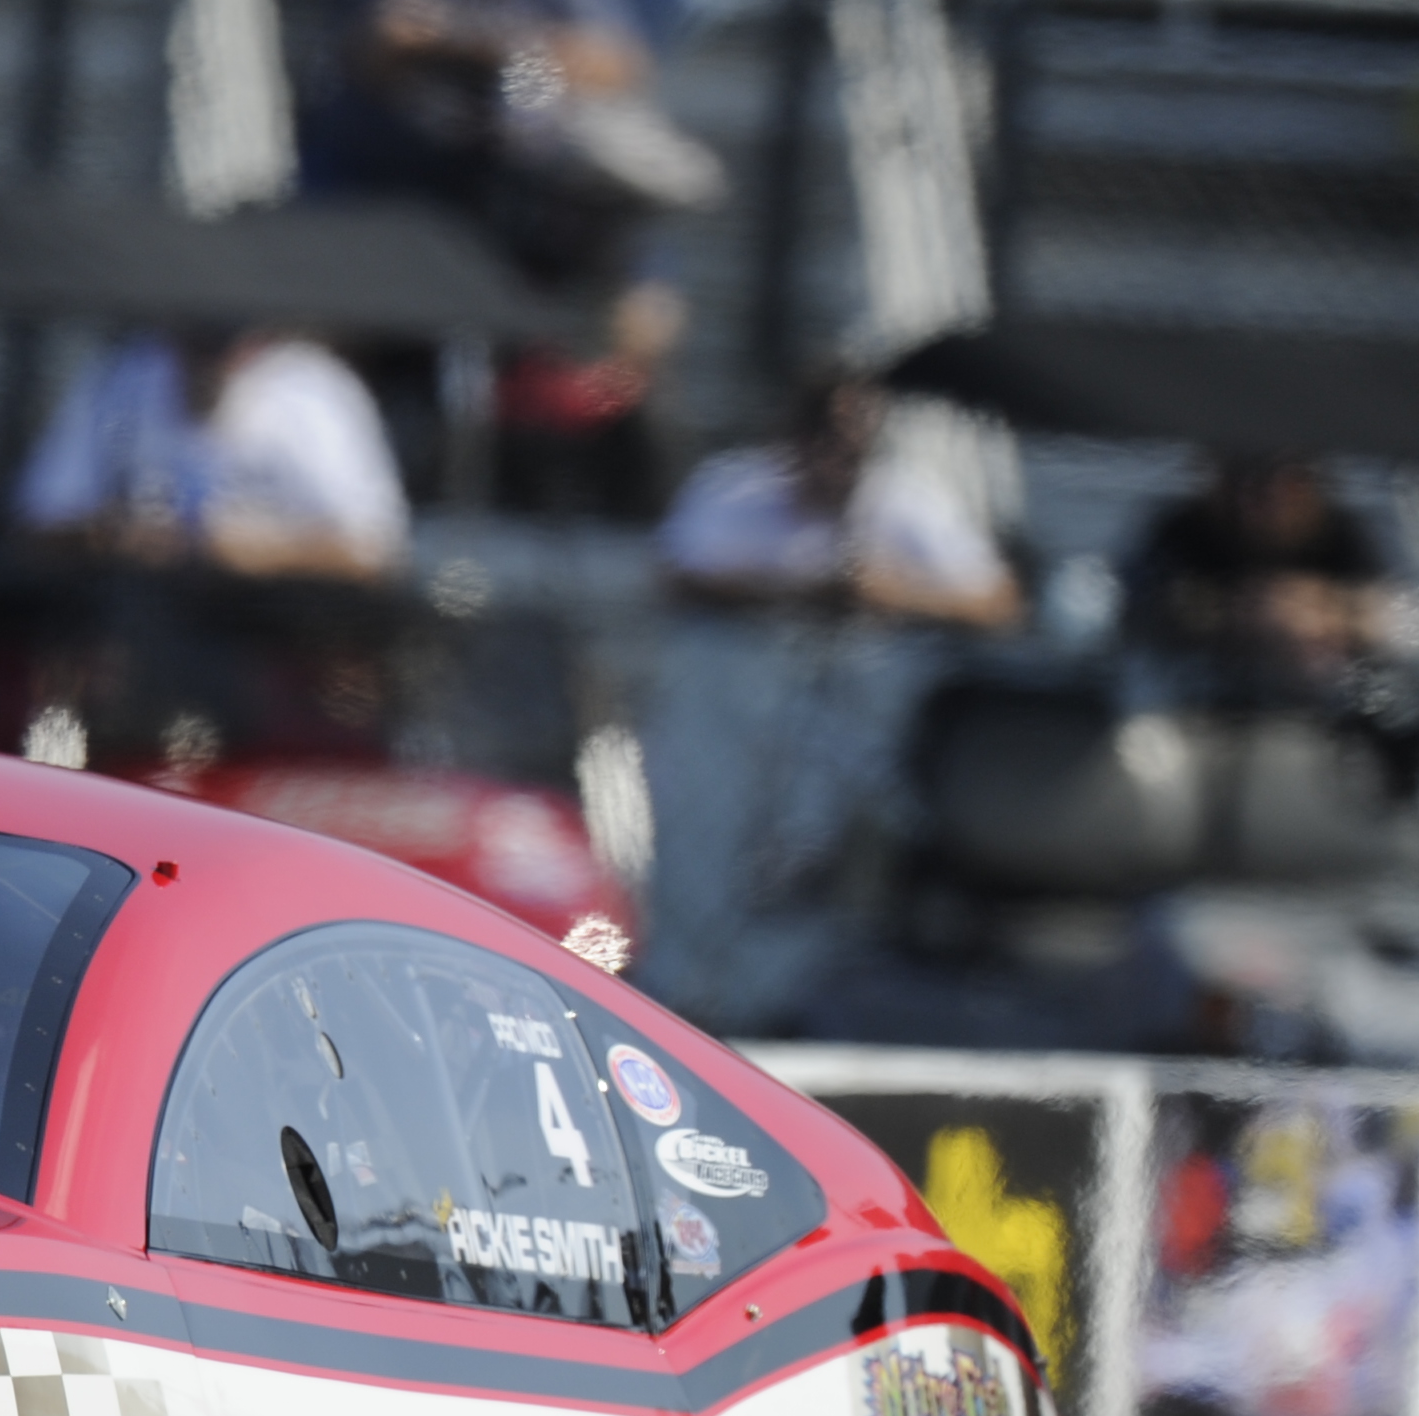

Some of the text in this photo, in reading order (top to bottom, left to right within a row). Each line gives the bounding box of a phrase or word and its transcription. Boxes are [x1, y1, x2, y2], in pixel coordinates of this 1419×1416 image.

[533, 1061, 593, 1188] 4
[448, 1207, 538, 1273] RICKIE
[532, 1216, 625, 1285] SMITH
